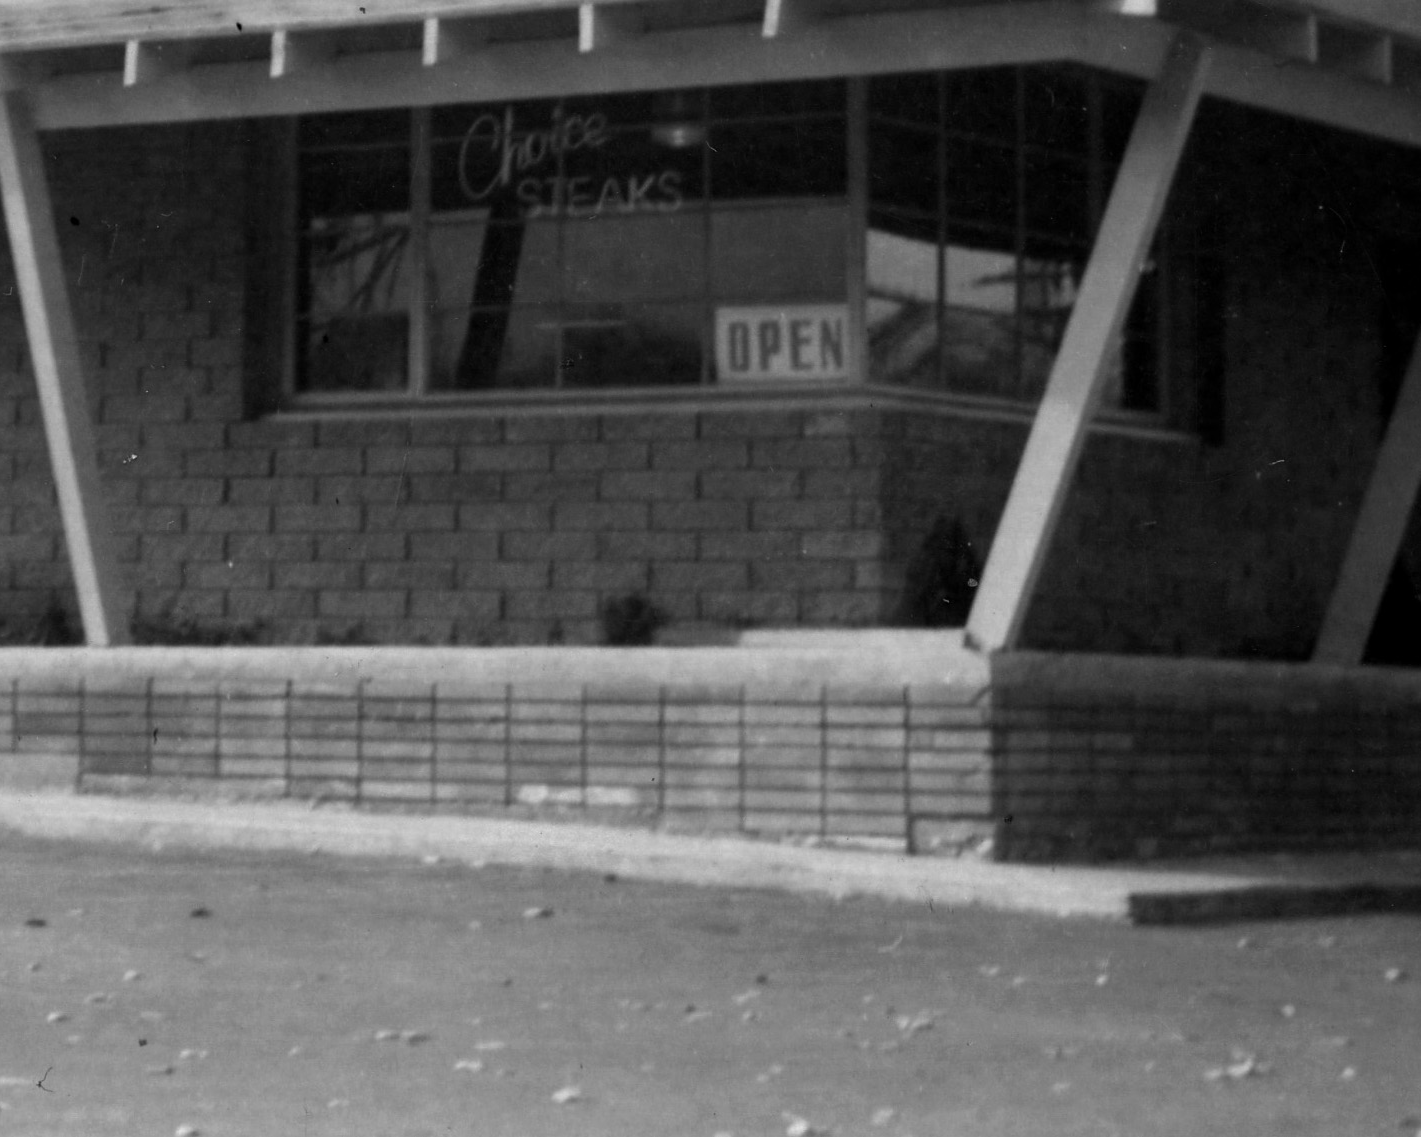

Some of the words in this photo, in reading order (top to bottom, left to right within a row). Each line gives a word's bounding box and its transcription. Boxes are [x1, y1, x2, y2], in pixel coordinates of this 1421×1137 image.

[459, 105, 610, 199] Choice
[516, 170, 681, 217] STEAKS
[729, 319, 843, 372] OPEN
